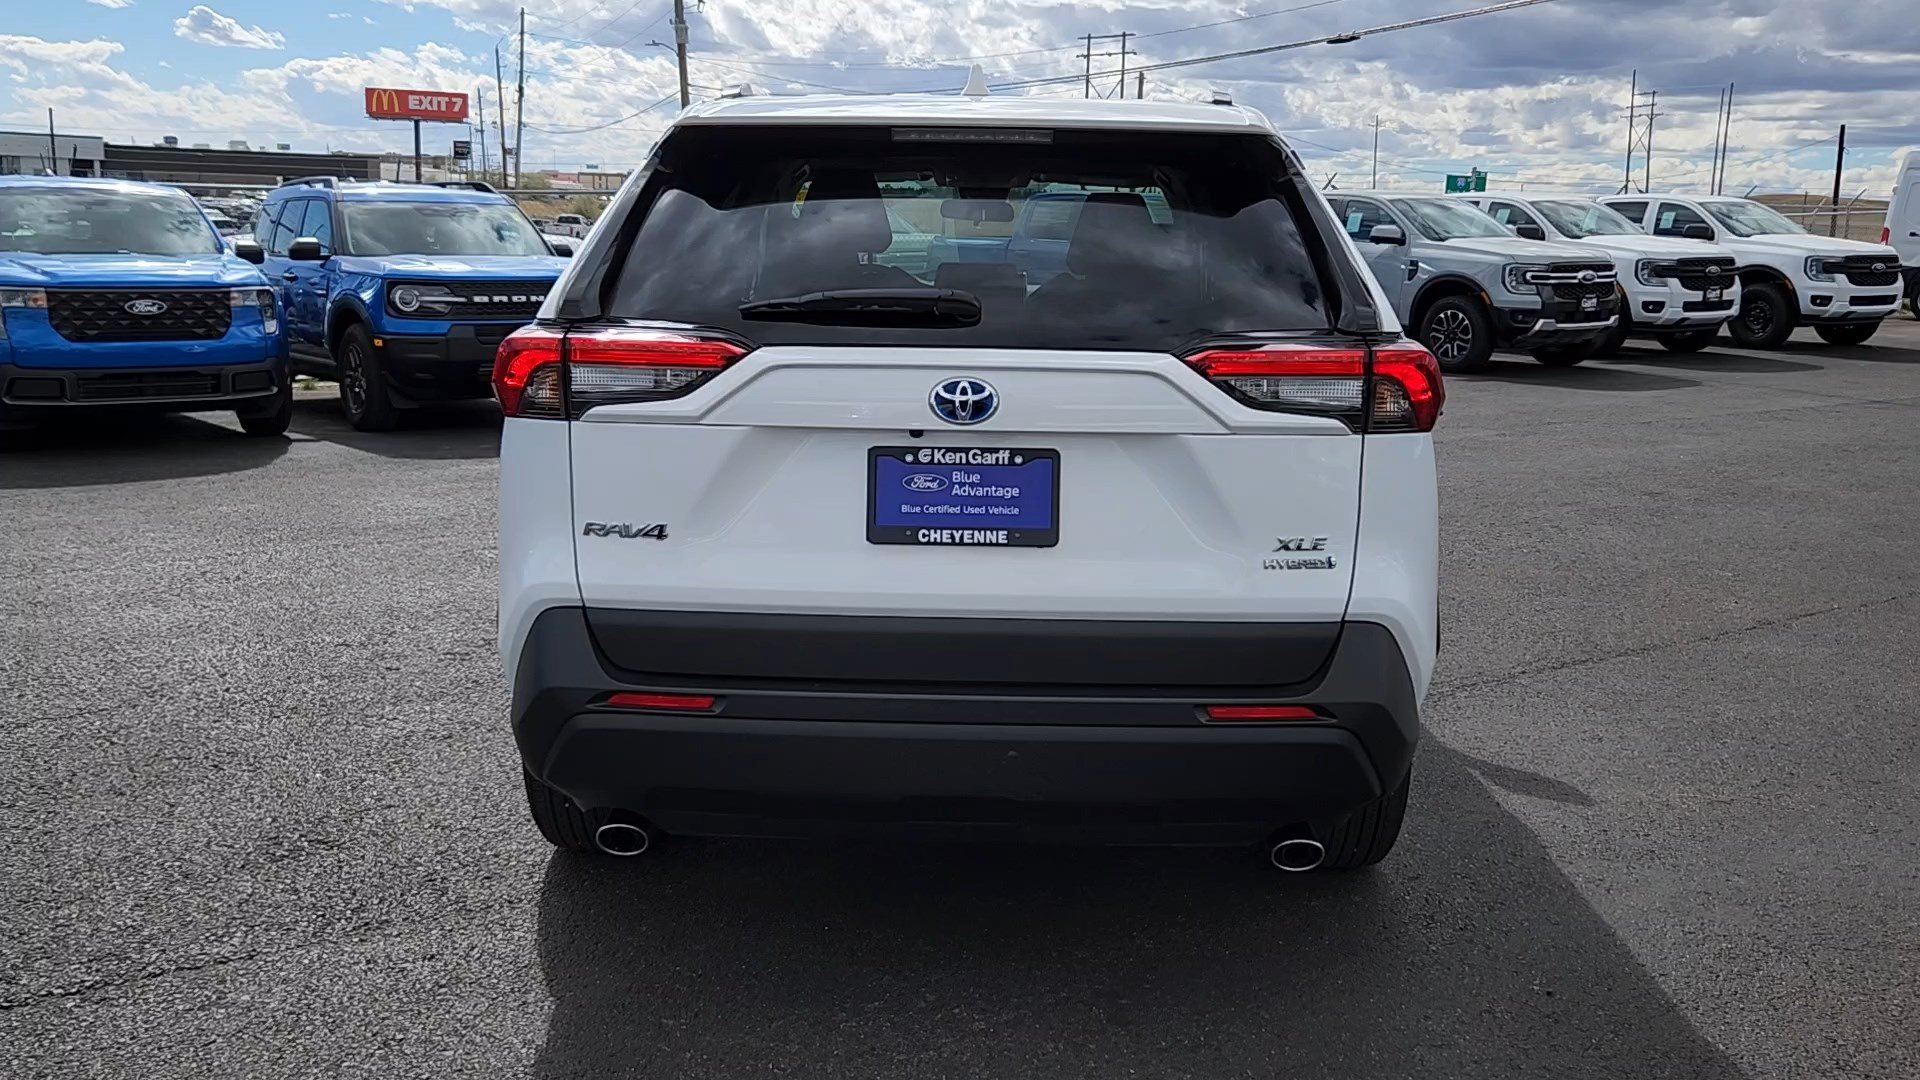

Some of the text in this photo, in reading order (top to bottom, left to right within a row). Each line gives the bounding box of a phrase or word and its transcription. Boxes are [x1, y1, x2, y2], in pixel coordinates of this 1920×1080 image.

[408, 94, 464, 112] EXIT 7
[933, 449, 1011, 465] Ken Garff
[910, 475, 940, 490] Ford
[952, 471, 981, 483] Blue
[951, 485, 1020, 499] Advantage
[901, 504, 1020, 515] Blue Certified Used Vehicle
[582, 521, 668, 541] RAV4
[917, 529, 1009, 544] CHEYENNE
[1272, 536, 1328, 552] XLE
[1263, 558, 1329, 570] HYBRID
